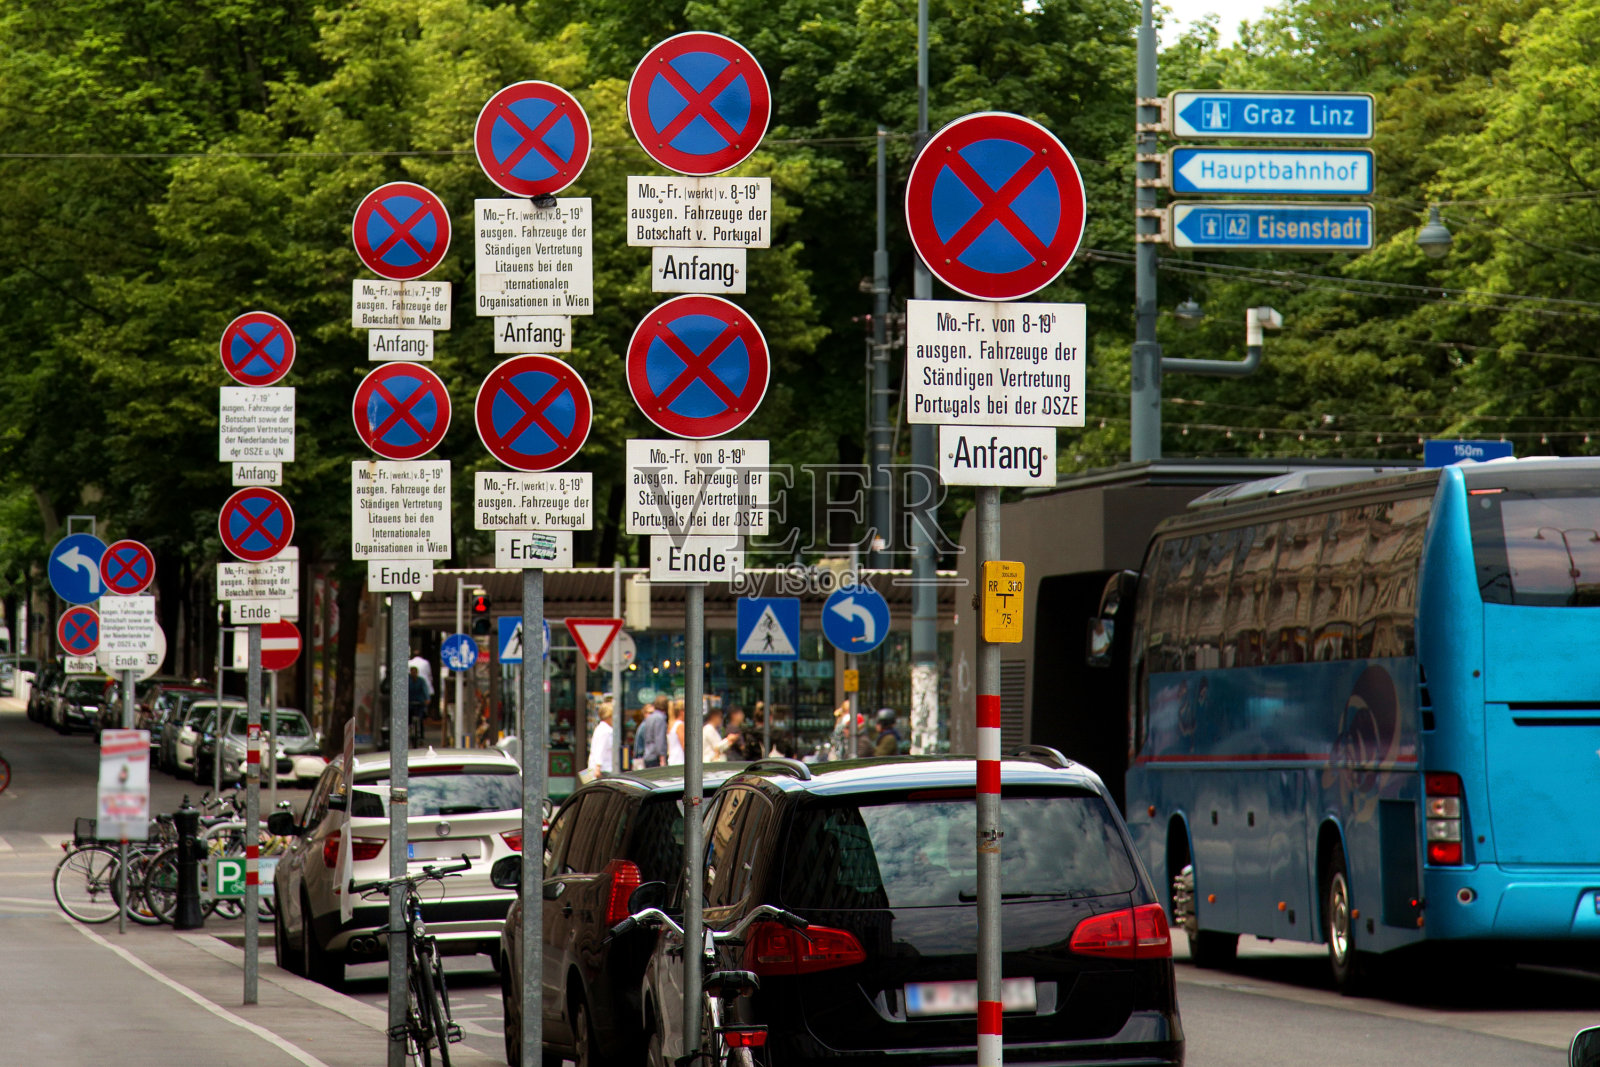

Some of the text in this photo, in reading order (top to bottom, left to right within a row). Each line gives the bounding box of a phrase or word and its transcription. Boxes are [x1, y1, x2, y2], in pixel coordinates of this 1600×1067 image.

[1244, 104, 1354, 126] Graz Linz
[1201, 160, 1359, 184] Hauptbahnhof
[639, 184, 681, 199] Mo.-Fr.
[719, 191, 727, 199] v.
[631, 205, 767, 223] ausgen. Fahrzeuge der
[480, 226, 586, 240] ausgen. Fahrzeuge der
[637, 225, 762, 244] Botschaft v. Portugal
[1228, 216, 1362, 239] A2 Eisenstadt
[485, 243, 583, 257] Ständigen Vertretung
[496, 260, 573, 272] Litauens bei den
[663, 255, 734, 287] Anfang
[357, 300, 447, 312] ausgen. Fahrzeuge der
[480, 295, 589, 310] Organisationen in Wien
[362, 313, 441, 325] Botschaft von Malta
[937, 312, 985, 332] Mo.-Fr.
[992, 319, 1015, 333] von
[504, 323, 562, 347] Anfang
[376, 334, 425, 356] Anfang
[916, 341, 1077, 364] ausgen. Fahrzeuge der
[923, 366, 1070, 392] Ständigen Vertretung
[249, 404, 281, 413] Fahrzeuge
[283, 404, 293, 412] der
[915, 394, 1078, 418] Portugals bei der OSZE
[225, 415, 256, 423] Botschaft
[280, 415, 289, 423] der
[221, 425, 293, 435] Ständigen Vertretung
[230, 448, 241, 456] der
[244, 448, 263, 456] OSZE
[650, 449, 688, 463] Mo.-Fr.
[694, 453, 712, 463] von
[953, 436, 1042, 478] Anfang
[1454, 445, 1483, 456] 150m
[238, 466, 276, 482] Anfang
[633, 470, 762, 488] ausgen. Fahrzeuge der
[356, 484, 446, 496] ausgen. Fahrzeuge der
[484, 478, 519, 490] Mo.-Fr.
[360, 499, 442, 511] Ständigen Vertretung
[478, 496, 589, 510] ausgen. Fahrzeuge der
[639, 491, 757, 509] Ständigen Vertretung
[368, 512, 434, 523] Litauens bei den
[482, 513, 585, 527] Botschaft v. Portugal
[632, 512, 763, 529] Portugals bei der OSZE
[372, 527, 430, 538] Internationalen
[355, 542, 448, 555] Organisationen in Wien
[511, 539, 557, 559] En
[669, 546, 726, 572] Ende
[248, 578, 277, 586] Fahrzeuge
[381, 567, 420, 584] Ende
[989, 581, 998, 592] RR
[241, 605, 271, 618] Ende
[68, 661, 94, 671] Anfang
[115, 655, 138, 666] Ende
[218, 862, 241, 892] P
